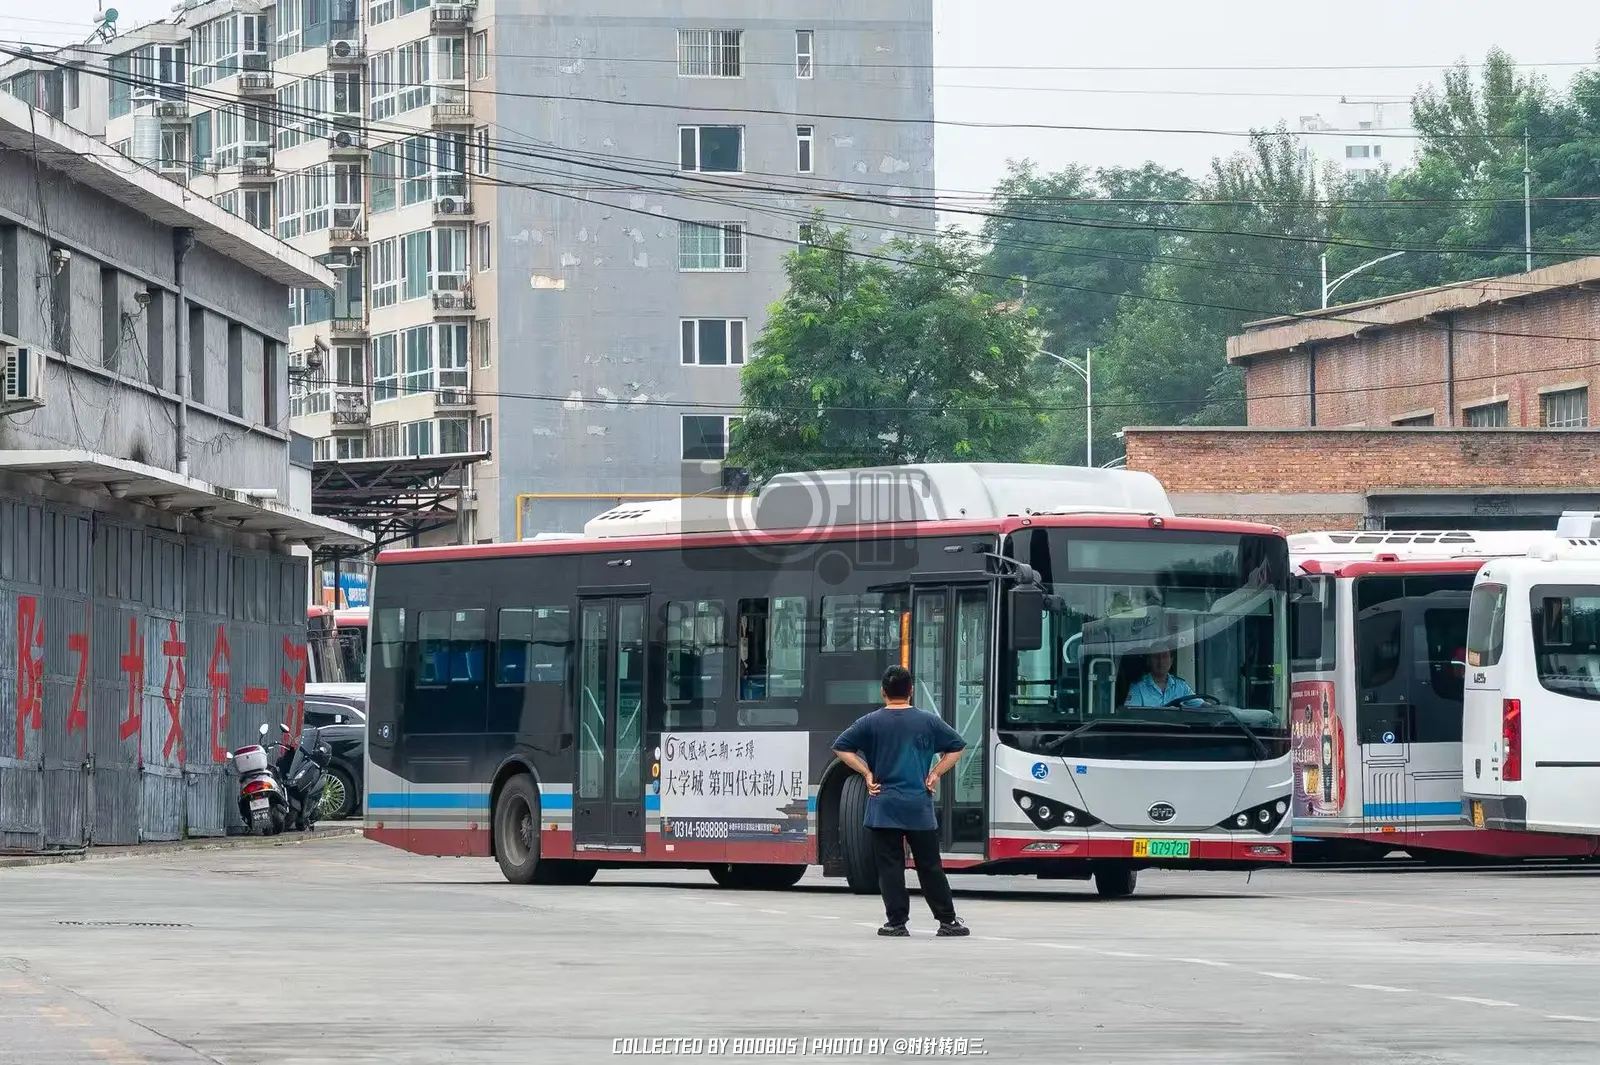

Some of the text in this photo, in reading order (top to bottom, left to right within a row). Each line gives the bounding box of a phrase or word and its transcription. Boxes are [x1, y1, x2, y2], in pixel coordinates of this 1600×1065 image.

[665, 769, 803, 798] 大学城 第四代宋韵人居
[674, 820, 729, 838] 0314-5898888
